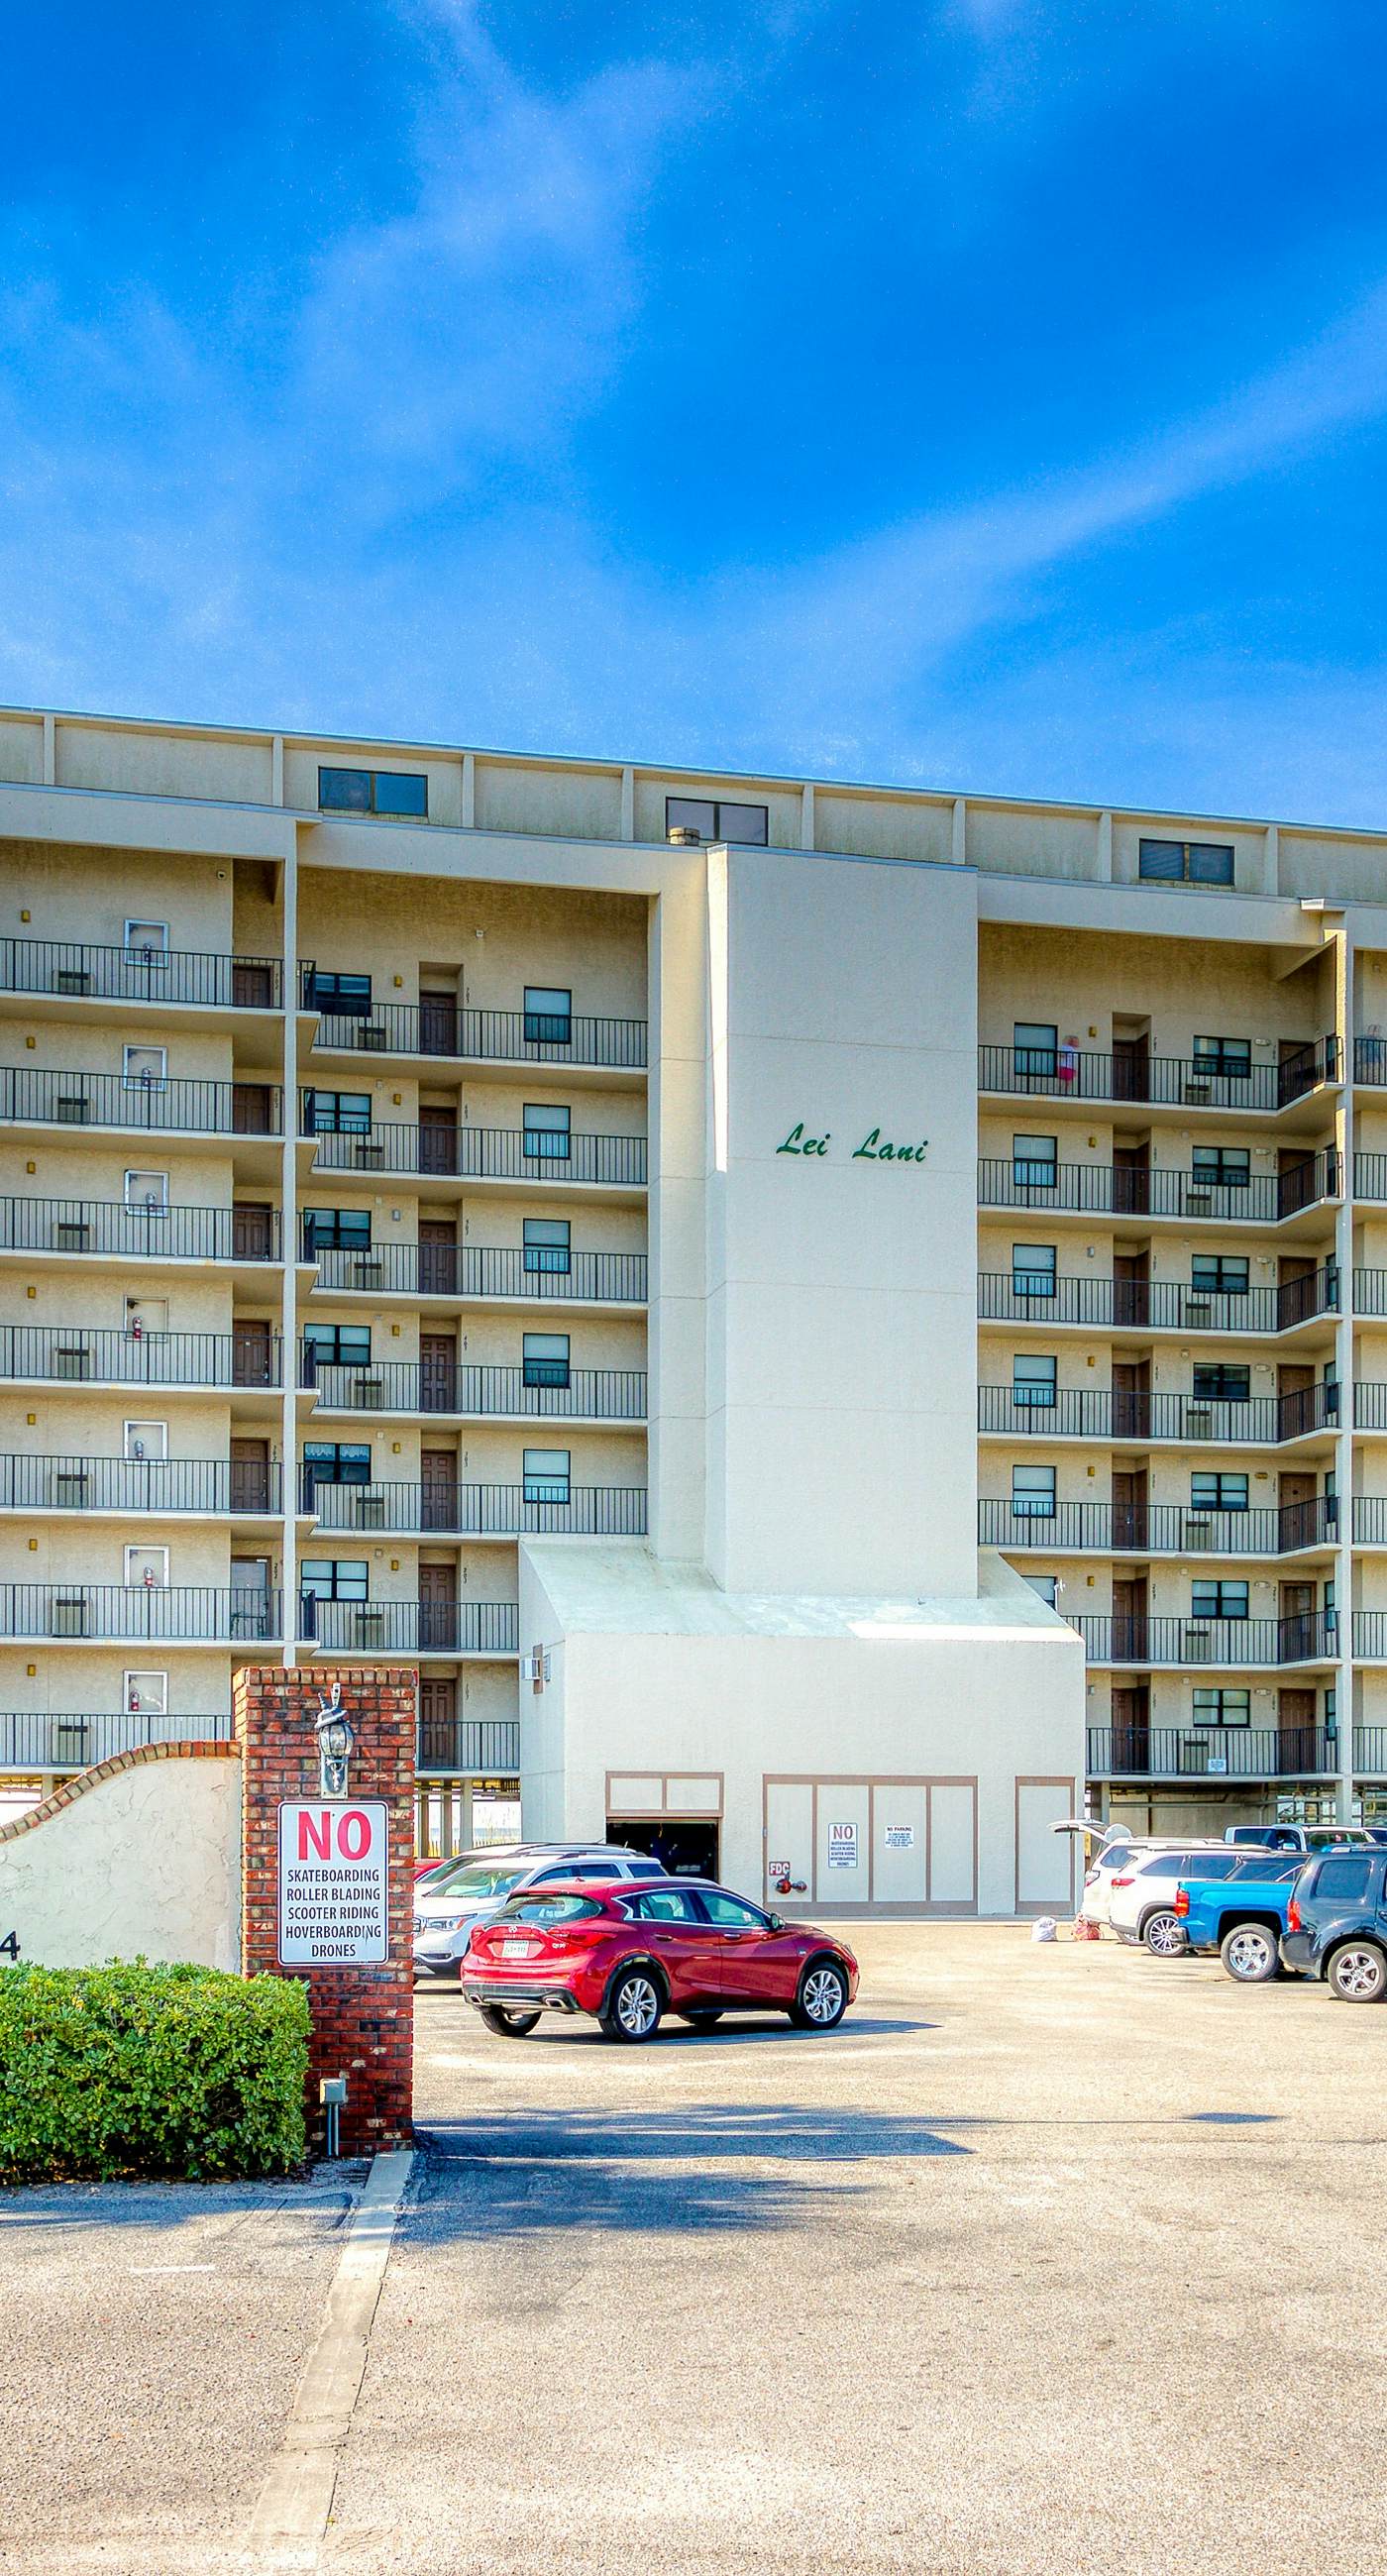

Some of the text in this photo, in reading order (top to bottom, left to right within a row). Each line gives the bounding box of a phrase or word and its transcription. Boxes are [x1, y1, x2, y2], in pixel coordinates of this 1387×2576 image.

[776, 1123, 928, 1163] Lei Lani
[298, 1810, 372, 1861] NO
[833, 1825, 853, 1840] NO
[287, 1869, 379, 1882] SKATEBOARDING
[770, 1863, 790, 1875] FDC
[286, 1887, 380, 1901] ROLLER BLADING
[288, 1906, 378, 1920] SCOOTER RIDING
[285, 1925, 381, 1939] HOVERBOARDING
[311, 1944, 356, 1958] DRONES
